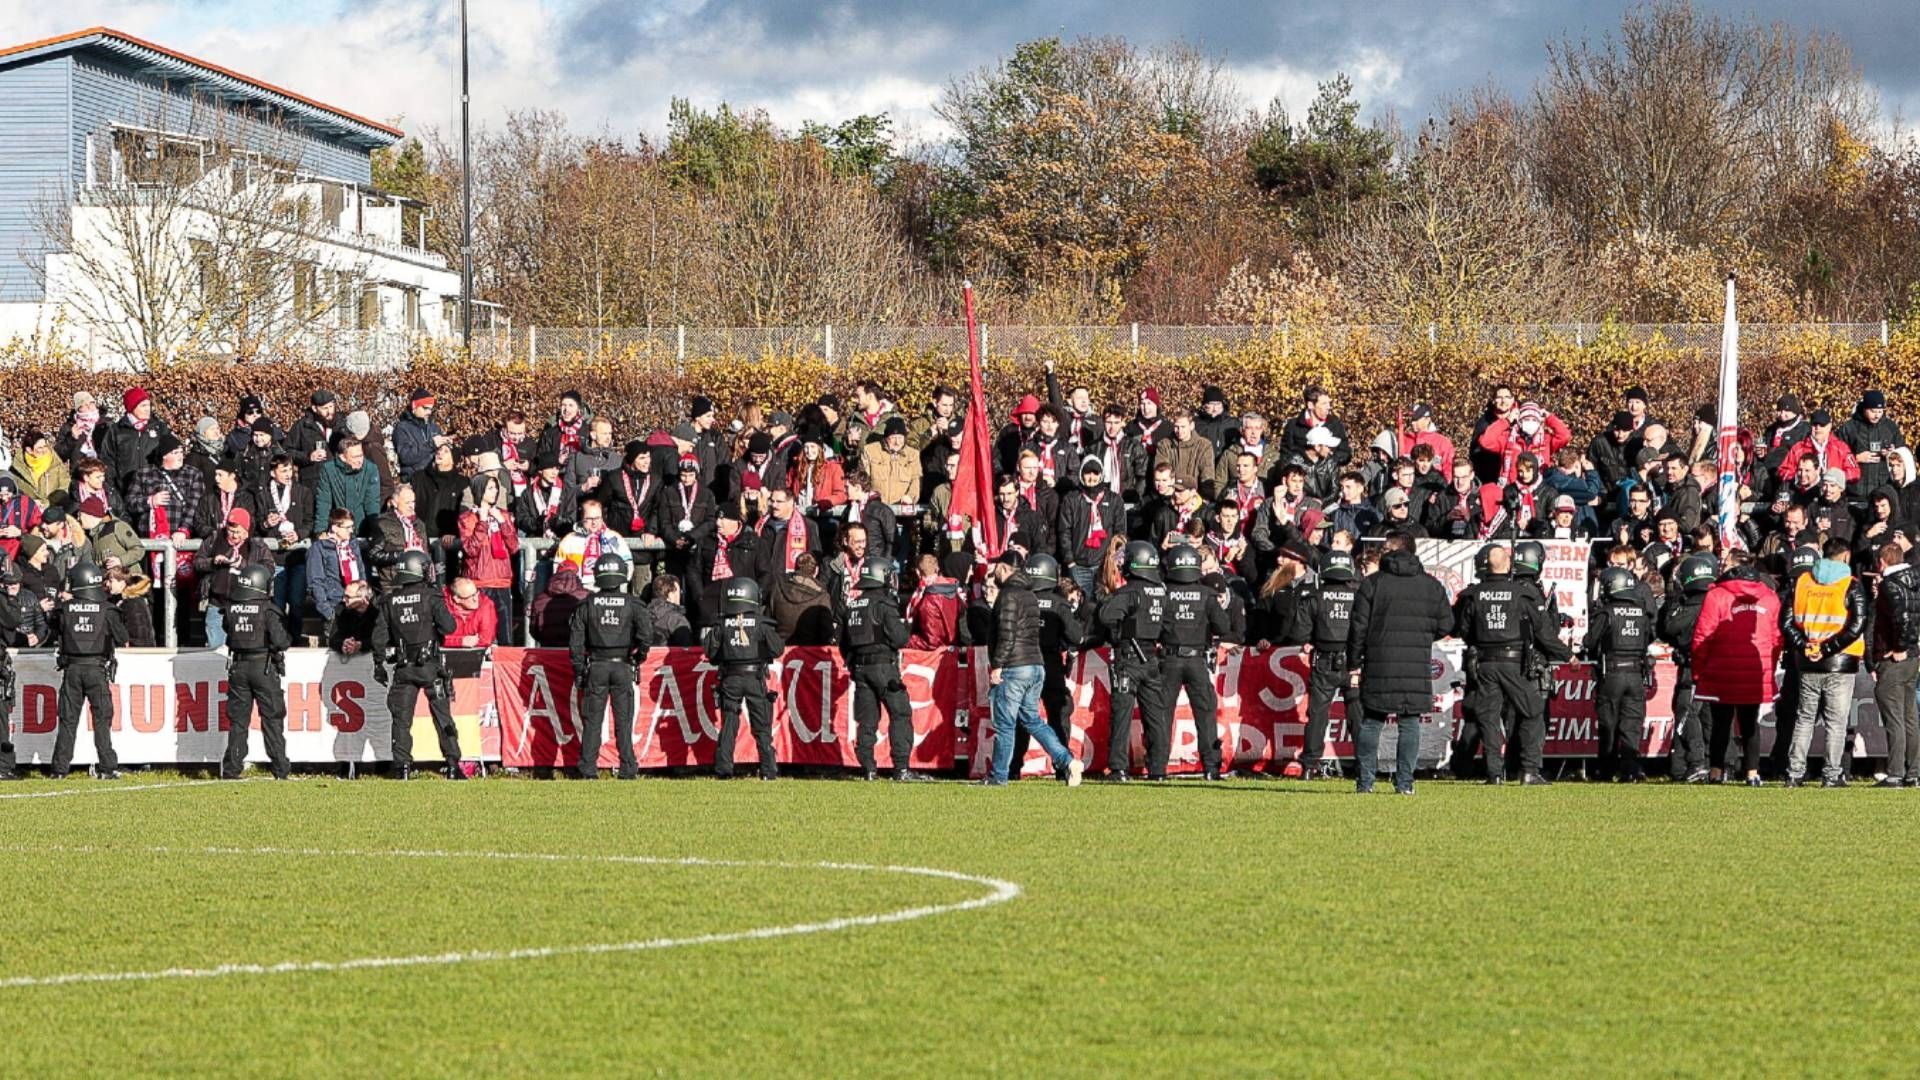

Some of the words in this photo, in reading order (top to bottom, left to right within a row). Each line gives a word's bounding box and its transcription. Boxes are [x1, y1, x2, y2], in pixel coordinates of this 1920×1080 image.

[392, 594, 421, 605] POLIZEI
[1170, 591, 1201, 601] POLIZEI
[1323, 591, 1355, 601] POLIZEI
[1479, 591, 1512, 601] POLIZEI
[594, 597, 625, 606] POLIZEI
[69, 603, 100, 613] POLIZEI
[230, 605, 259, 614] POLIZEI
[1178, 604, 1190, 612] BY
[1334, 602, 1345, 611] BY
[1490, 604, 1502, 613] BY
[403, 607, 414, 616] BY
[604, 609, 615, 617] BY
[1613, 607, 1643, 617] POLIZEI
[78, 616, 89, 624] BY
[238, 616, 249, 624] BY
[1626, 619, 1636, 628] BY
